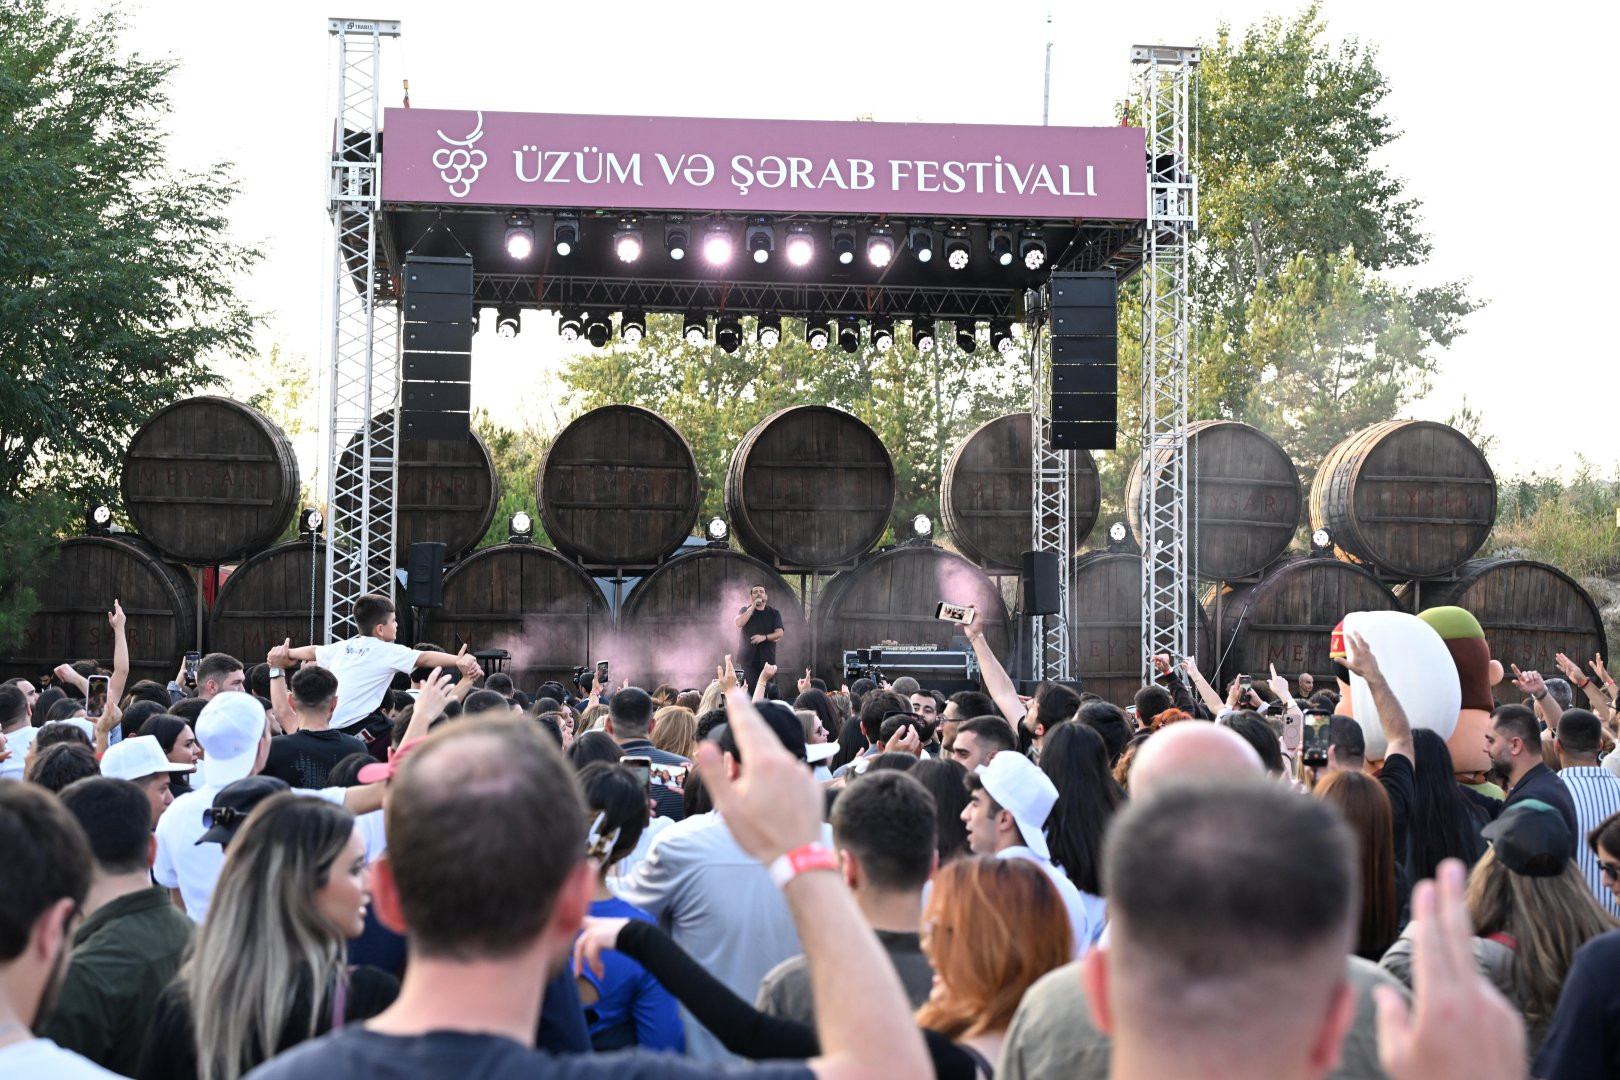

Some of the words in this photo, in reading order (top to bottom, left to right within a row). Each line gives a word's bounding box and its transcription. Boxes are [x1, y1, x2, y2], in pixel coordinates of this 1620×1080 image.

[512, 144, 644, 187] ÜZÜM
[654, 153, 715, 187] VƏ
[730, 154, 876, 196] ŞƏRAB
[887, 154, 1098, 197] FESTİVALI
[138, 464, 268, 489] MEYSARI
[374, 475, 482, 497] YARI
[1190, 493, 1290, 514] YSARI
[25, 627, 153, 647] MESRI
